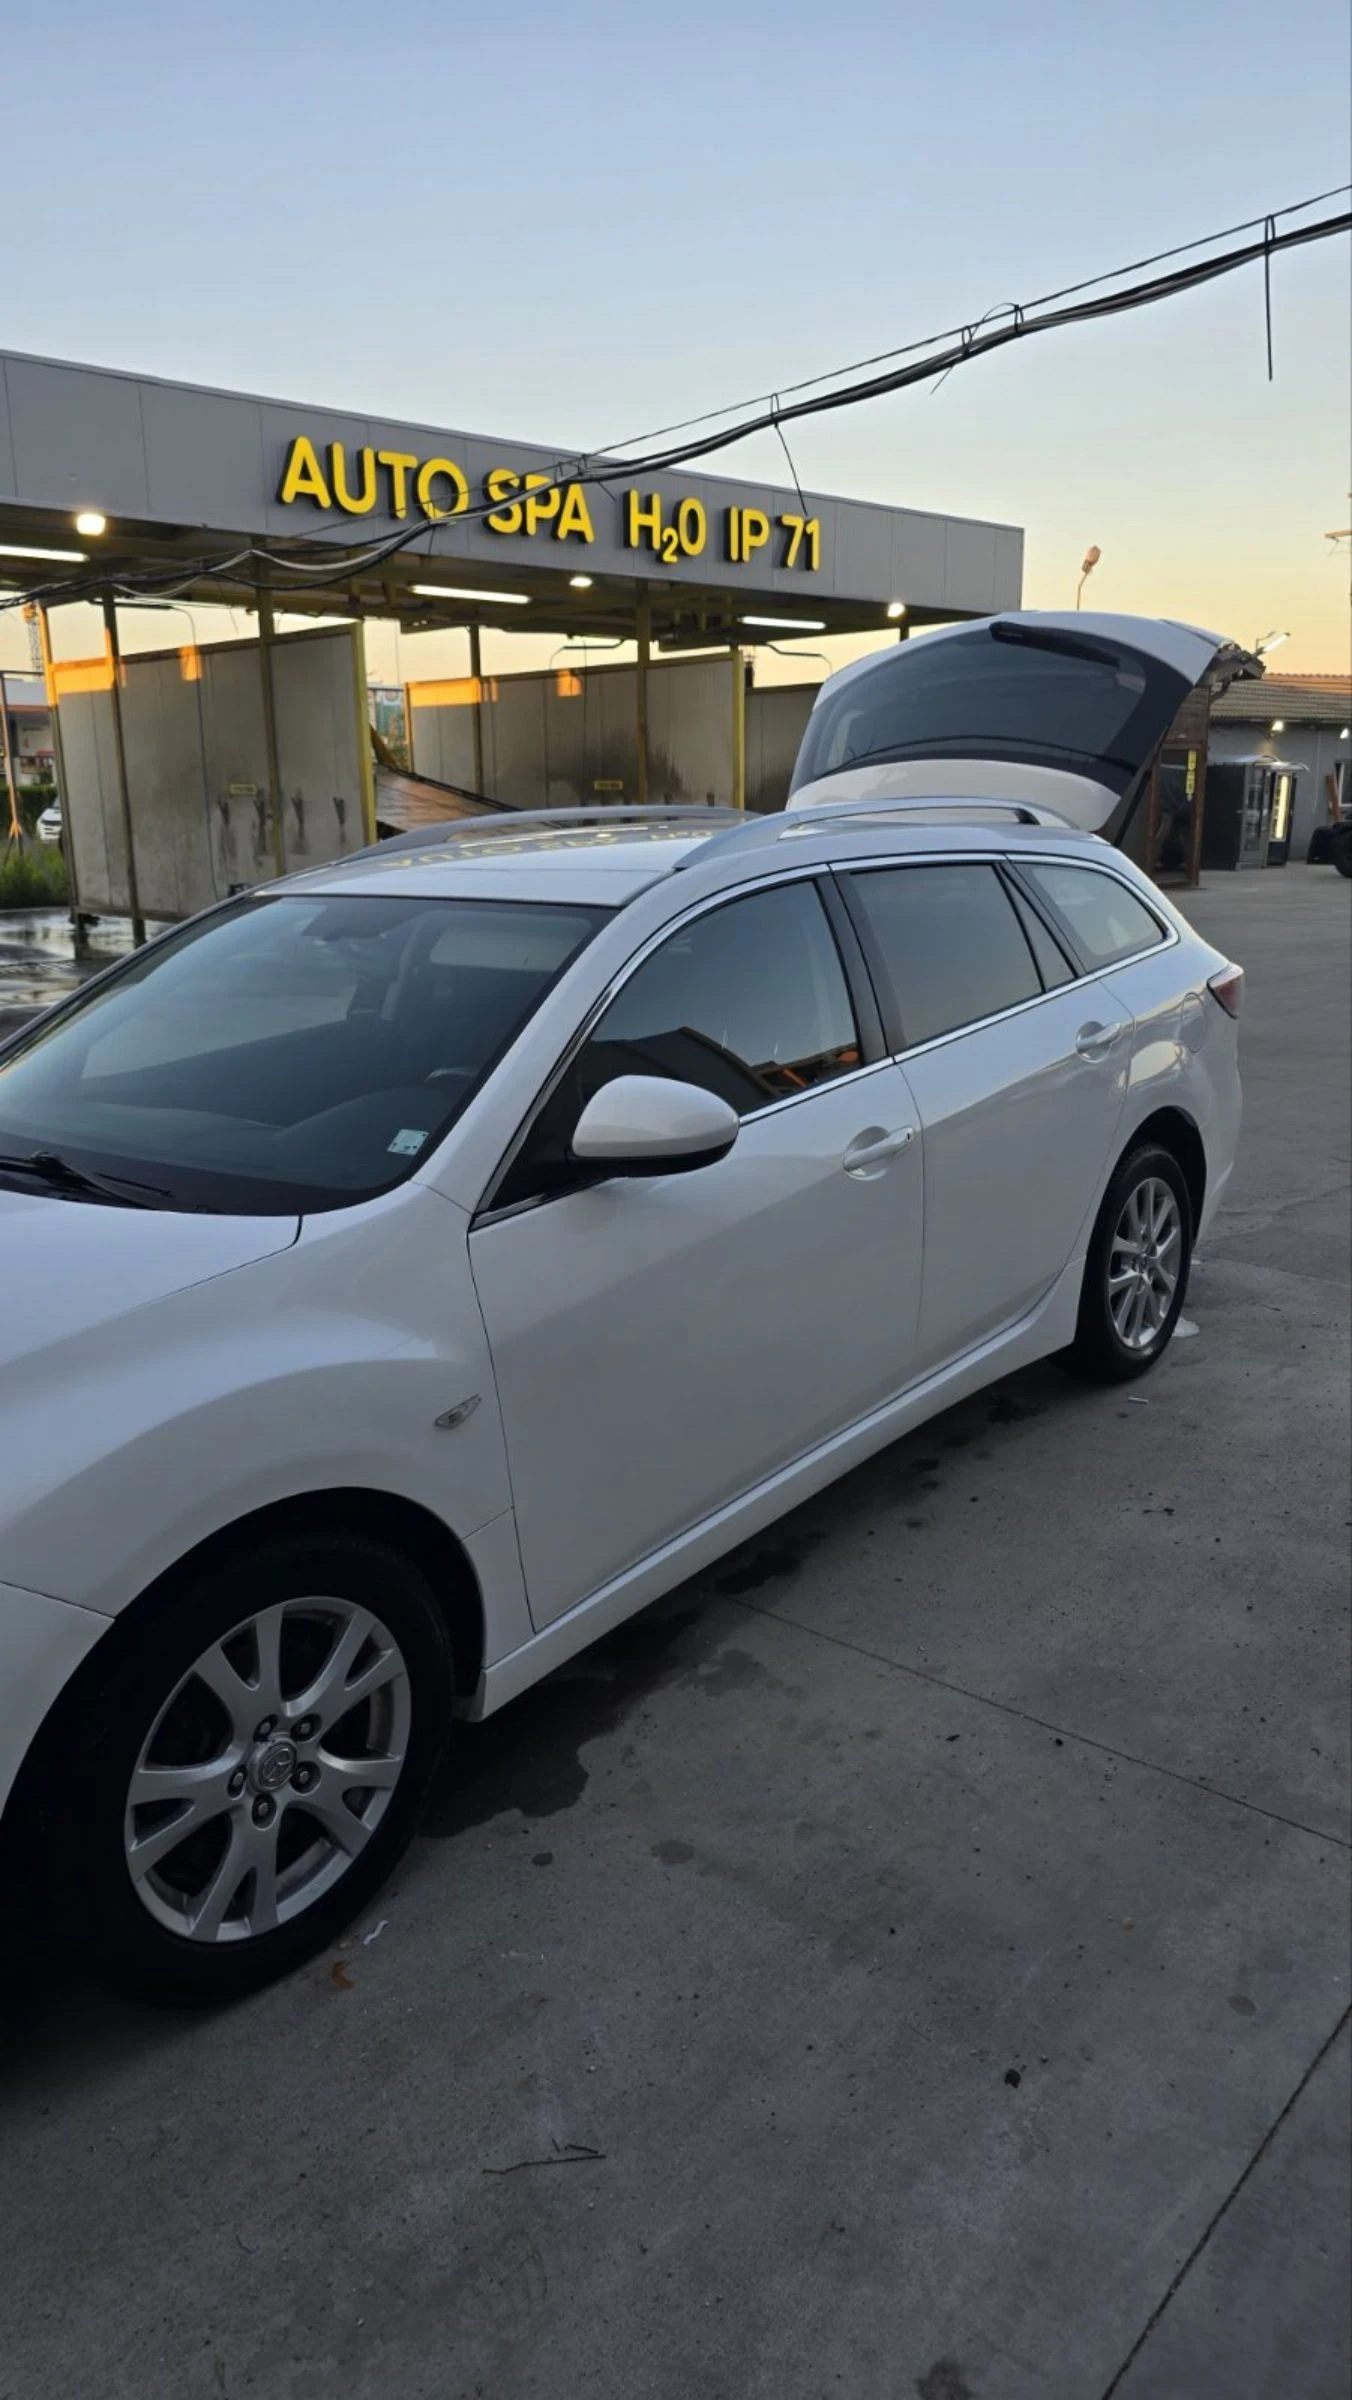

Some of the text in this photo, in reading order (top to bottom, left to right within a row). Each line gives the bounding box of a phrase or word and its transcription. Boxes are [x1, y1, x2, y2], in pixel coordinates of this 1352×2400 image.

[281, 435, 469, 520] AUTO
[488, 468, 595, 544] SPA
[729, 505, 770, 563] IP
[780, 514, 821, 570] 71
